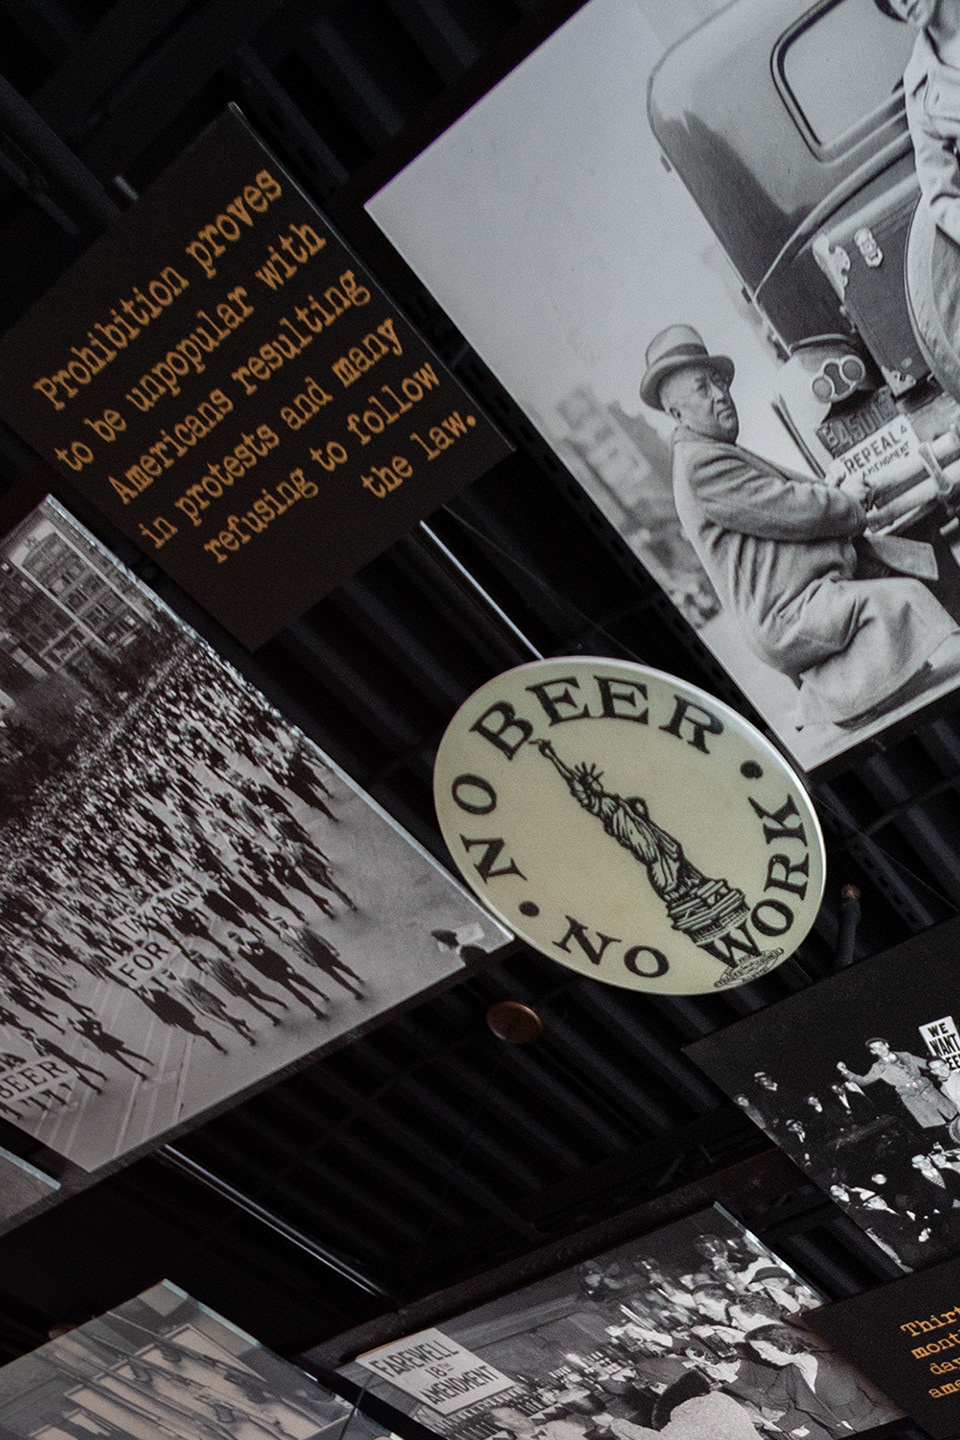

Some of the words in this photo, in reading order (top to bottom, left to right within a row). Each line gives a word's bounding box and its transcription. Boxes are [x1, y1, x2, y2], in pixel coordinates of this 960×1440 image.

[34, 266, 189, 410] Prohibition
[186, 169, 282, 278] proves
[55, 440, 94, 471] to
[84, 409, 127, 443] be
[127, 286, 254, 411] unpopular
[256, 221, 326, 290] with
[108, 388, 233, 504] Americans
[232, 270, 371, 395] resulting
[140, 515, 178, 549] in
[175, 423, 280, 526] protests
[280, 377, 333, 430] and
[332, 318, 403, 387] many
[204, 468, 319, 563] refusing
[310, 440, 348, 471] to
[347, 362, 440, 444] follow
[361, 455, 413, 498] the
[410, 410, 477, 460] law.
[844, 431, 901, 474] REPEAL
[469, 675, 724, 760] BEER
[451, 773, 528, 884] NO
[553, 915, 670, 978] NO
[696, 794, 810, 970] WORK
[927, 1022, 949, 1038] WE
[929, 1033, 960, 1057] WANT
[368, 1339, 460, 1378] FAREWELL
[417, 1364, 500, 1405] AMENDMENT
